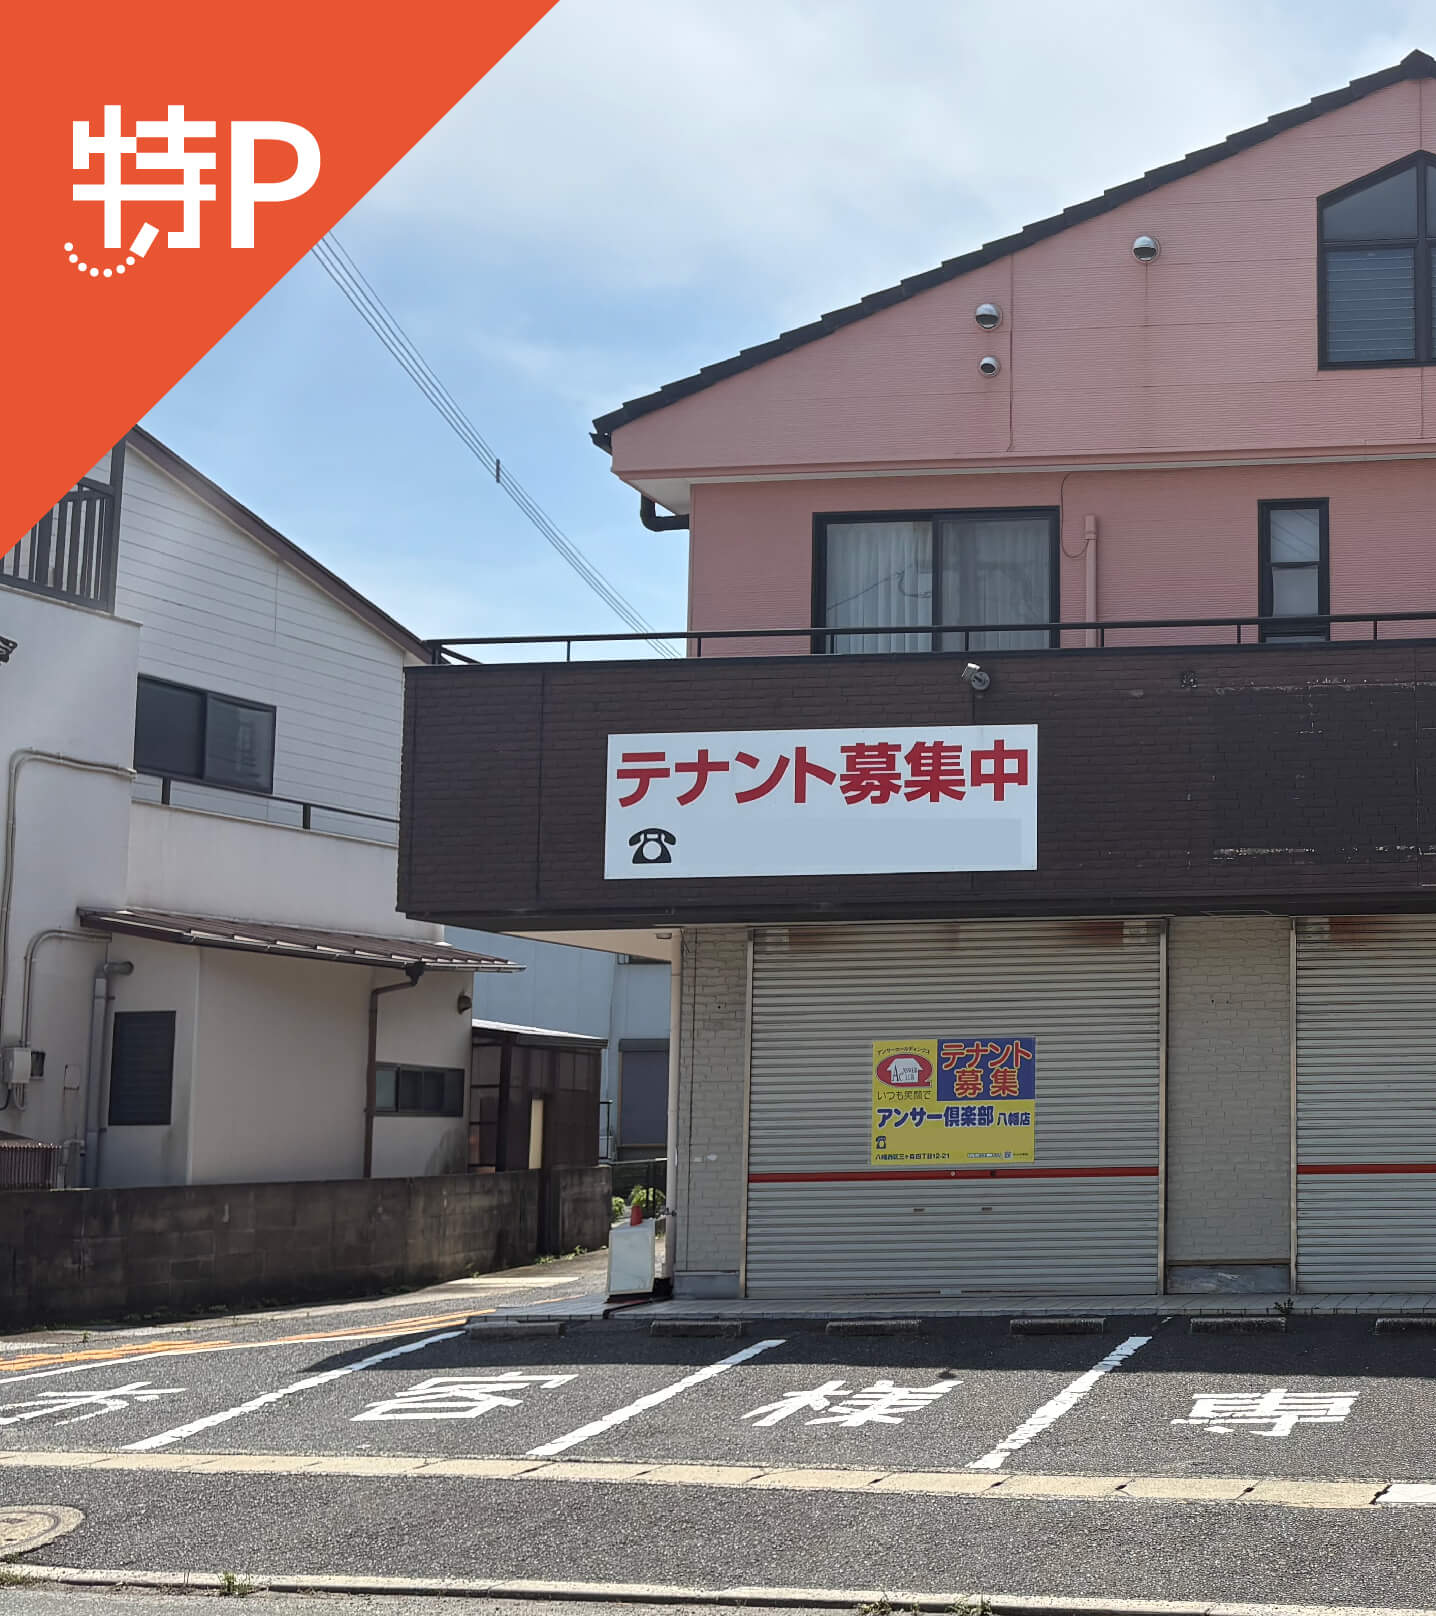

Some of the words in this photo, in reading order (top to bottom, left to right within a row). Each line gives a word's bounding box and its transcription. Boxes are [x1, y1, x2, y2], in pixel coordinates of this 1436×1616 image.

[616, 739, 1029, 808] テナント募集中
[941, 1040, 1032, 1069] テナント
[954, 1068, 1019, 1097] 募集
